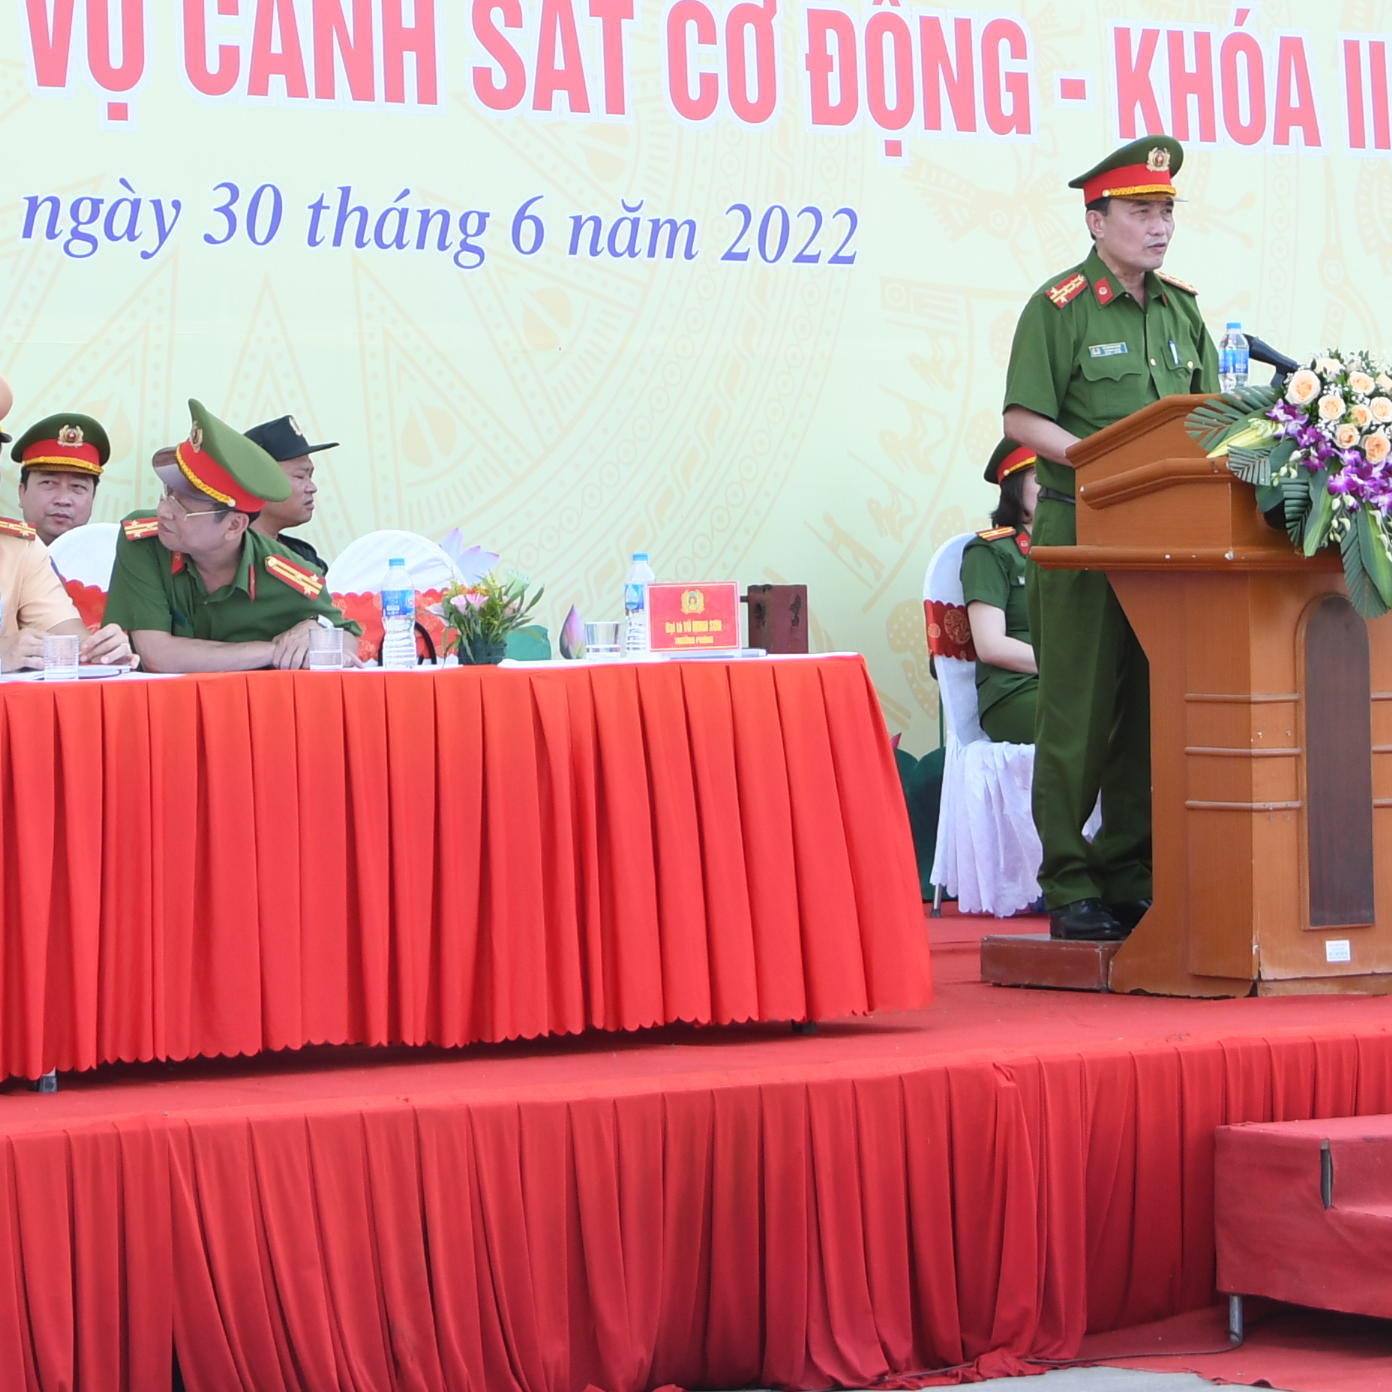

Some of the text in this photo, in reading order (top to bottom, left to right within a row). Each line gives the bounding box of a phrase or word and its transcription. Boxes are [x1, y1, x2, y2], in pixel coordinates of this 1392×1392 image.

[1062, 79, 1086, 99] -
[1115, 9, 1320, 149] KHÓA
[21, 177, 182, 261] ngày
[202, 181, 283, 247] 30
[306, 185, 491, 270] tháng
[511, 194, 545, 256] 6
[568, 198, 699, 261] năm
[720, 203, 859, 265] 2022
